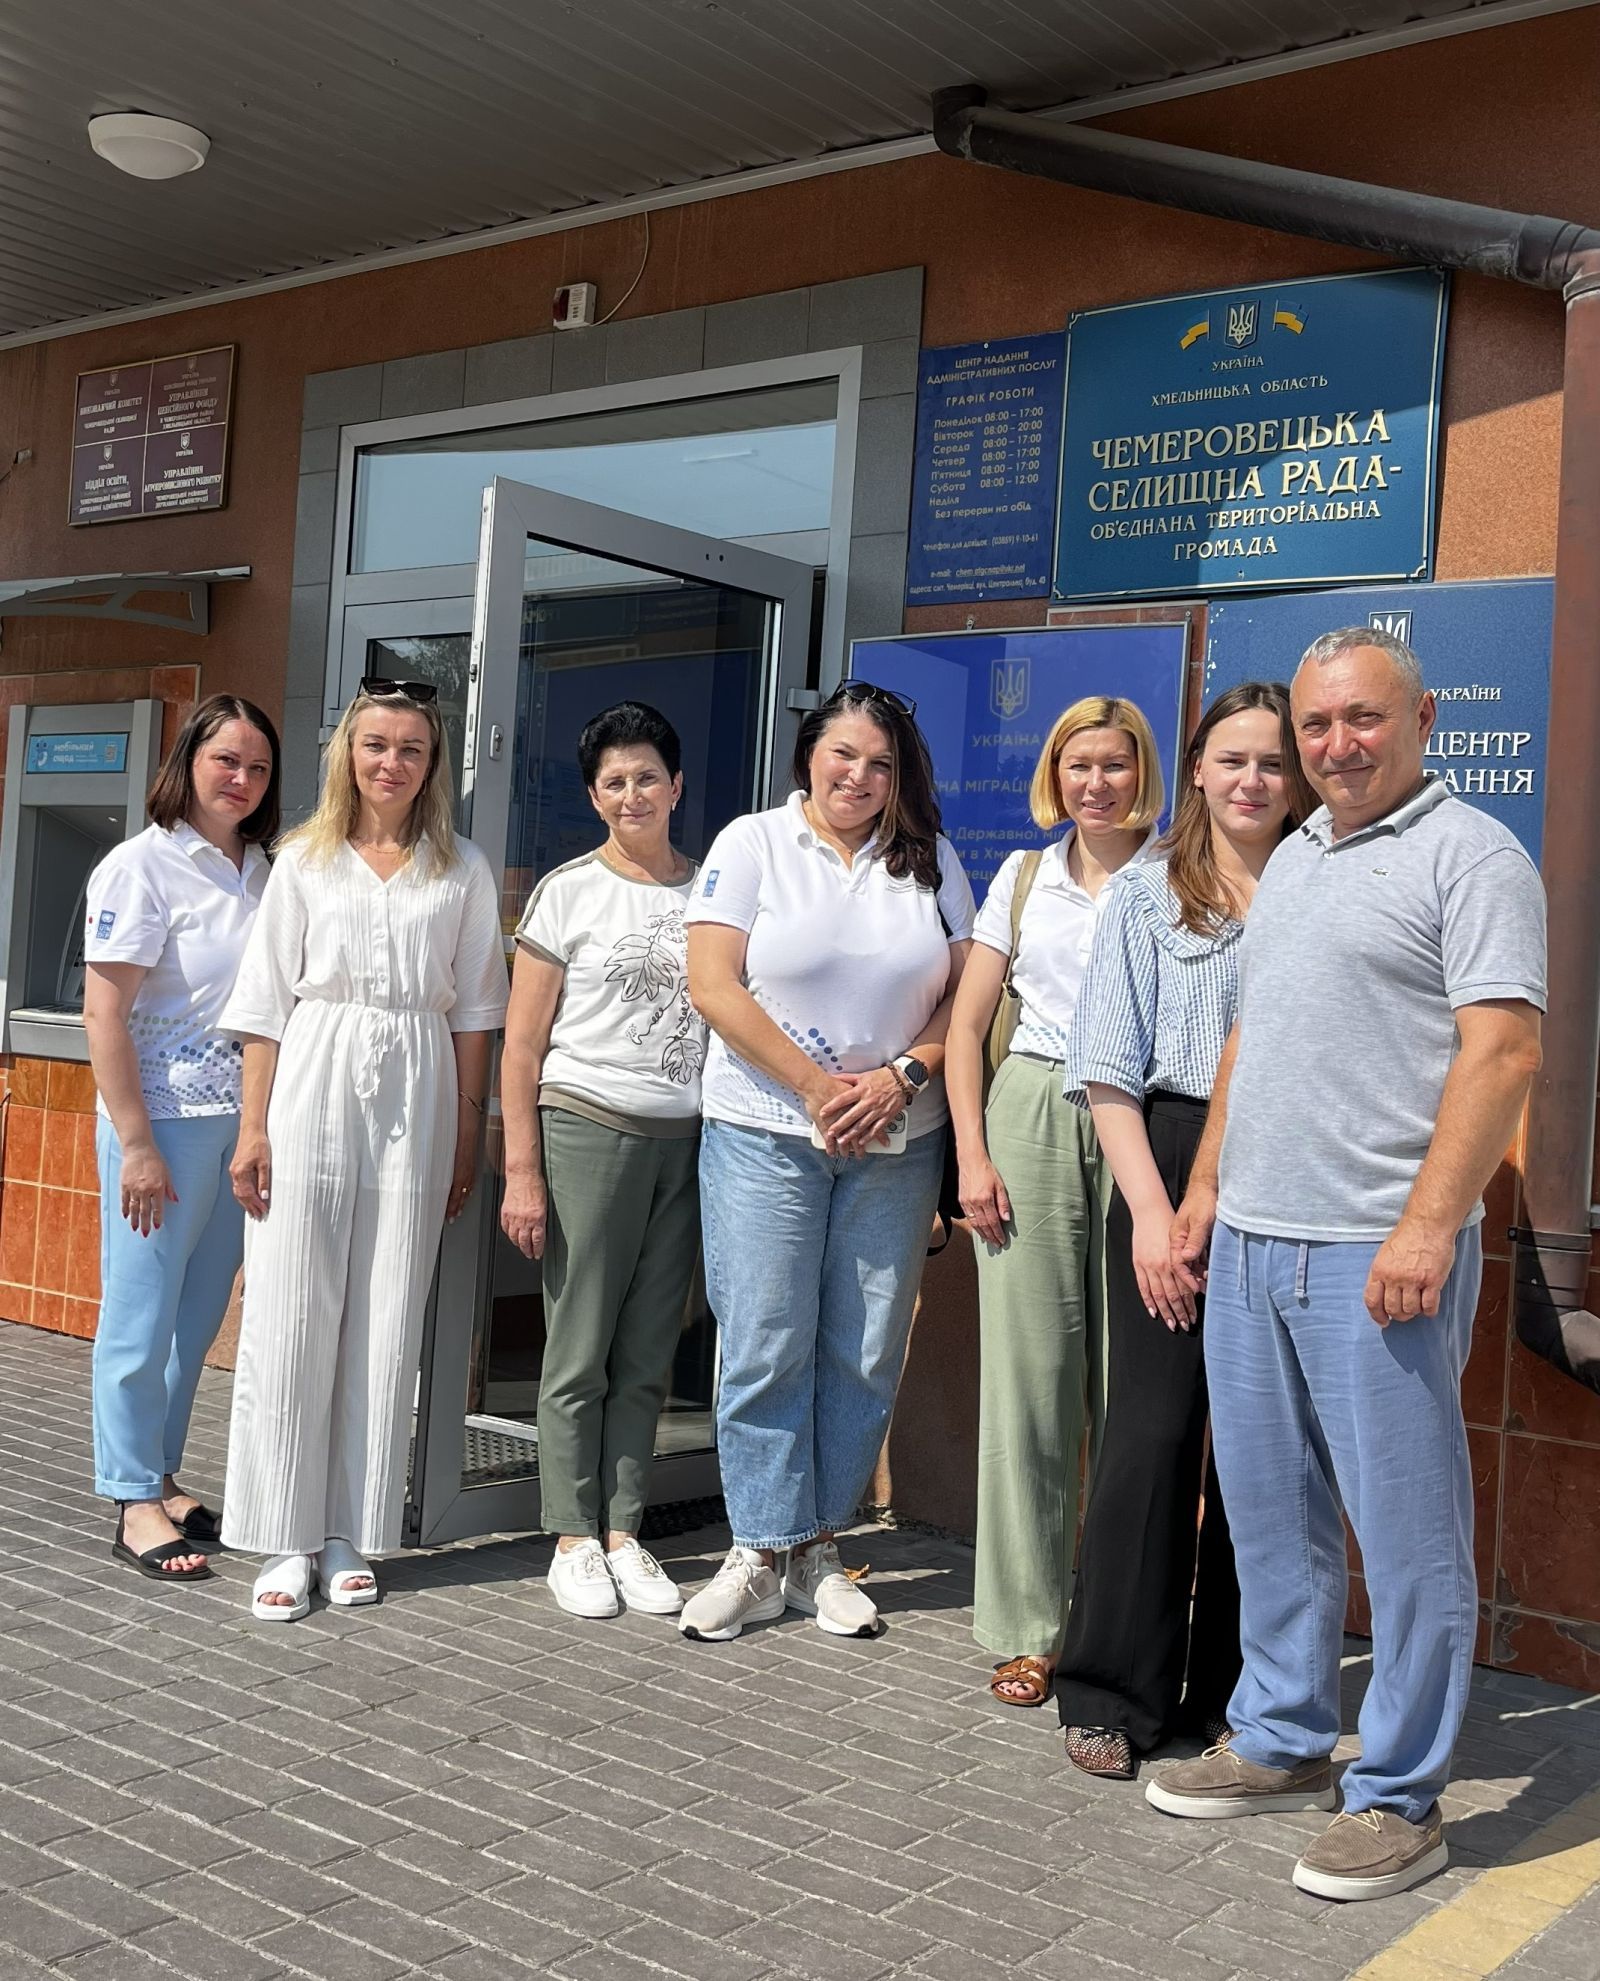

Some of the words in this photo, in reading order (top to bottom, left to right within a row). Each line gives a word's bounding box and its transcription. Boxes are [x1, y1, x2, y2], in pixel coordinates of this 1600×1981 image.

[955, 357, 982, 369] ЦЕНТР
[984, 351, 1030, 364] НАДАННЯ
[1211, 354, 1264, 373] УКРАЇНА
[926, 365, 1017, 385] АДМІНІСТРАТИВНИХ
[1018, 359, 1057, 373] ПОСЛУГ
[946, 392, 985, 407] ГРАФІК
[989, 386, 1035, 402] РОБОТИ
[1151, 383, 1251, 407] ХМЕЛЬНИЦЬКА
[1260, 374, 1329, 394] ОБЛАСТЬ
[934, 416, 983, 429] Понеділок
[985, 411, 1009, 422] 08:00
[1019, 406, 1044, 418] 17:00
[933, 429, 975, 442] Вівторок
[983, 424, 1008, 436] 08:00
[1017, 420, 1043, 432] 20:00
[1091, 408, 1391, 471] ЧЕМЕРОВЕЦЬКА
[933, 443, 970, 455] Середа
[982, 437, 1008, 449] 08:00
[1017, 433, 1042, 445] 17:00
[931, 457, 966, 467] Четвер
[982, 451, 1007, 462] 08:00
[1016, 446, 1041, 458] 17:00
[981, 464, 1006, 475] 08:00
[1015, 460, 1040, 471] 17:00
[930, 482, 966, 494] Субота
[980, 477, 1005, 488] 08:00
[1014, 473, 1039, 485] 12:00
[1087, 464, 1265, 513] СЕЛИЩНА
[1280, 454, 1403, 496] РАДА-
[929, 496, 960, 506] Неділя
[935, 509, 951, 519] Без
[952, 506, 994, 517] перерви
[995, 504, 1008, 513] на
[1010, 501, 1032, 511] обід
[1090, 514, 1197, 541] ОБ'ЄДНАНА
[1173, 536, 1278, 561] ГРОМАДА
[1430, 684, 1503, 702] УКРАЇНИ
[972, 733, 1041, 748] УКРАЇНА
[1423, 731, 1532, 761] ЦЕНТР
[965, 776, 1031, 794] МІГРАЦІ
[956, 826, 1038, 842] Державної
